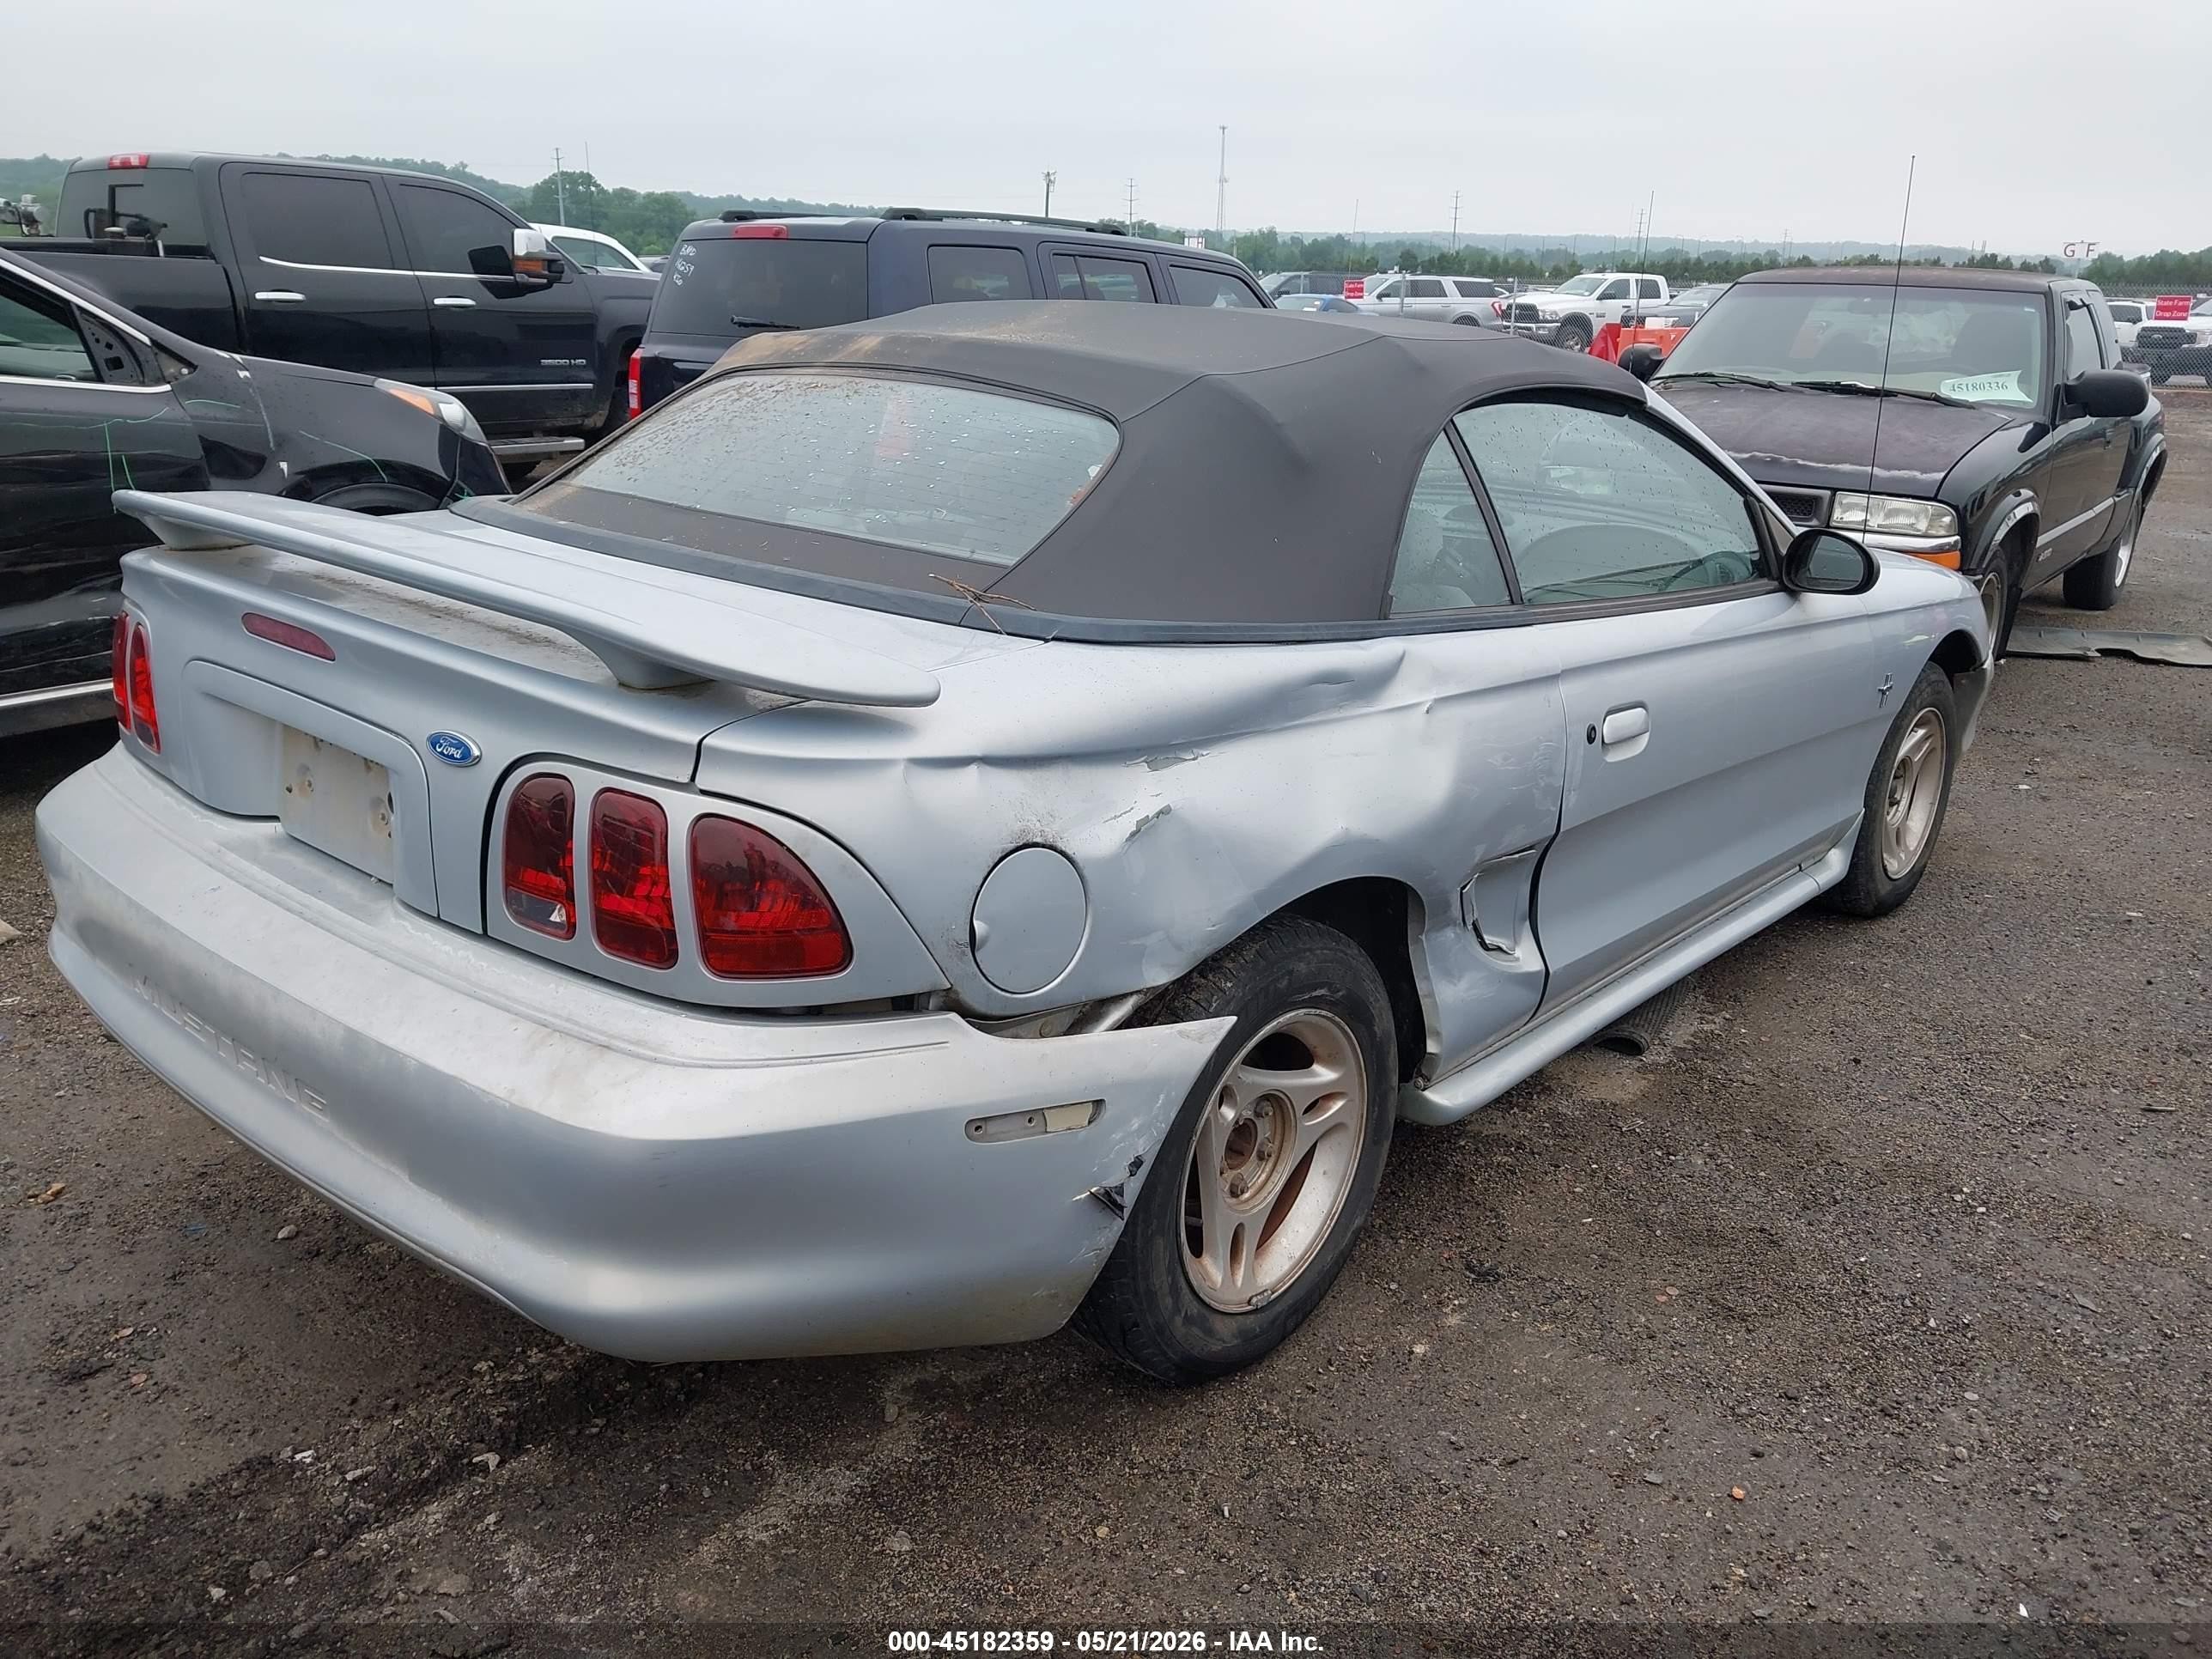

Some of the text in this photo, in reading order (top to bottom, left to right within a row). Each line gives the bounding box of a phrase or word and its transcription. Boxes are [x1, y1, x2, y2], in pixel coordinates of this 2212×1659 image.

[2063, 243, 2096, 258] G F
[1949, 380, 2008, 392] 45180336
[435, 735, 465, 759] Ford
